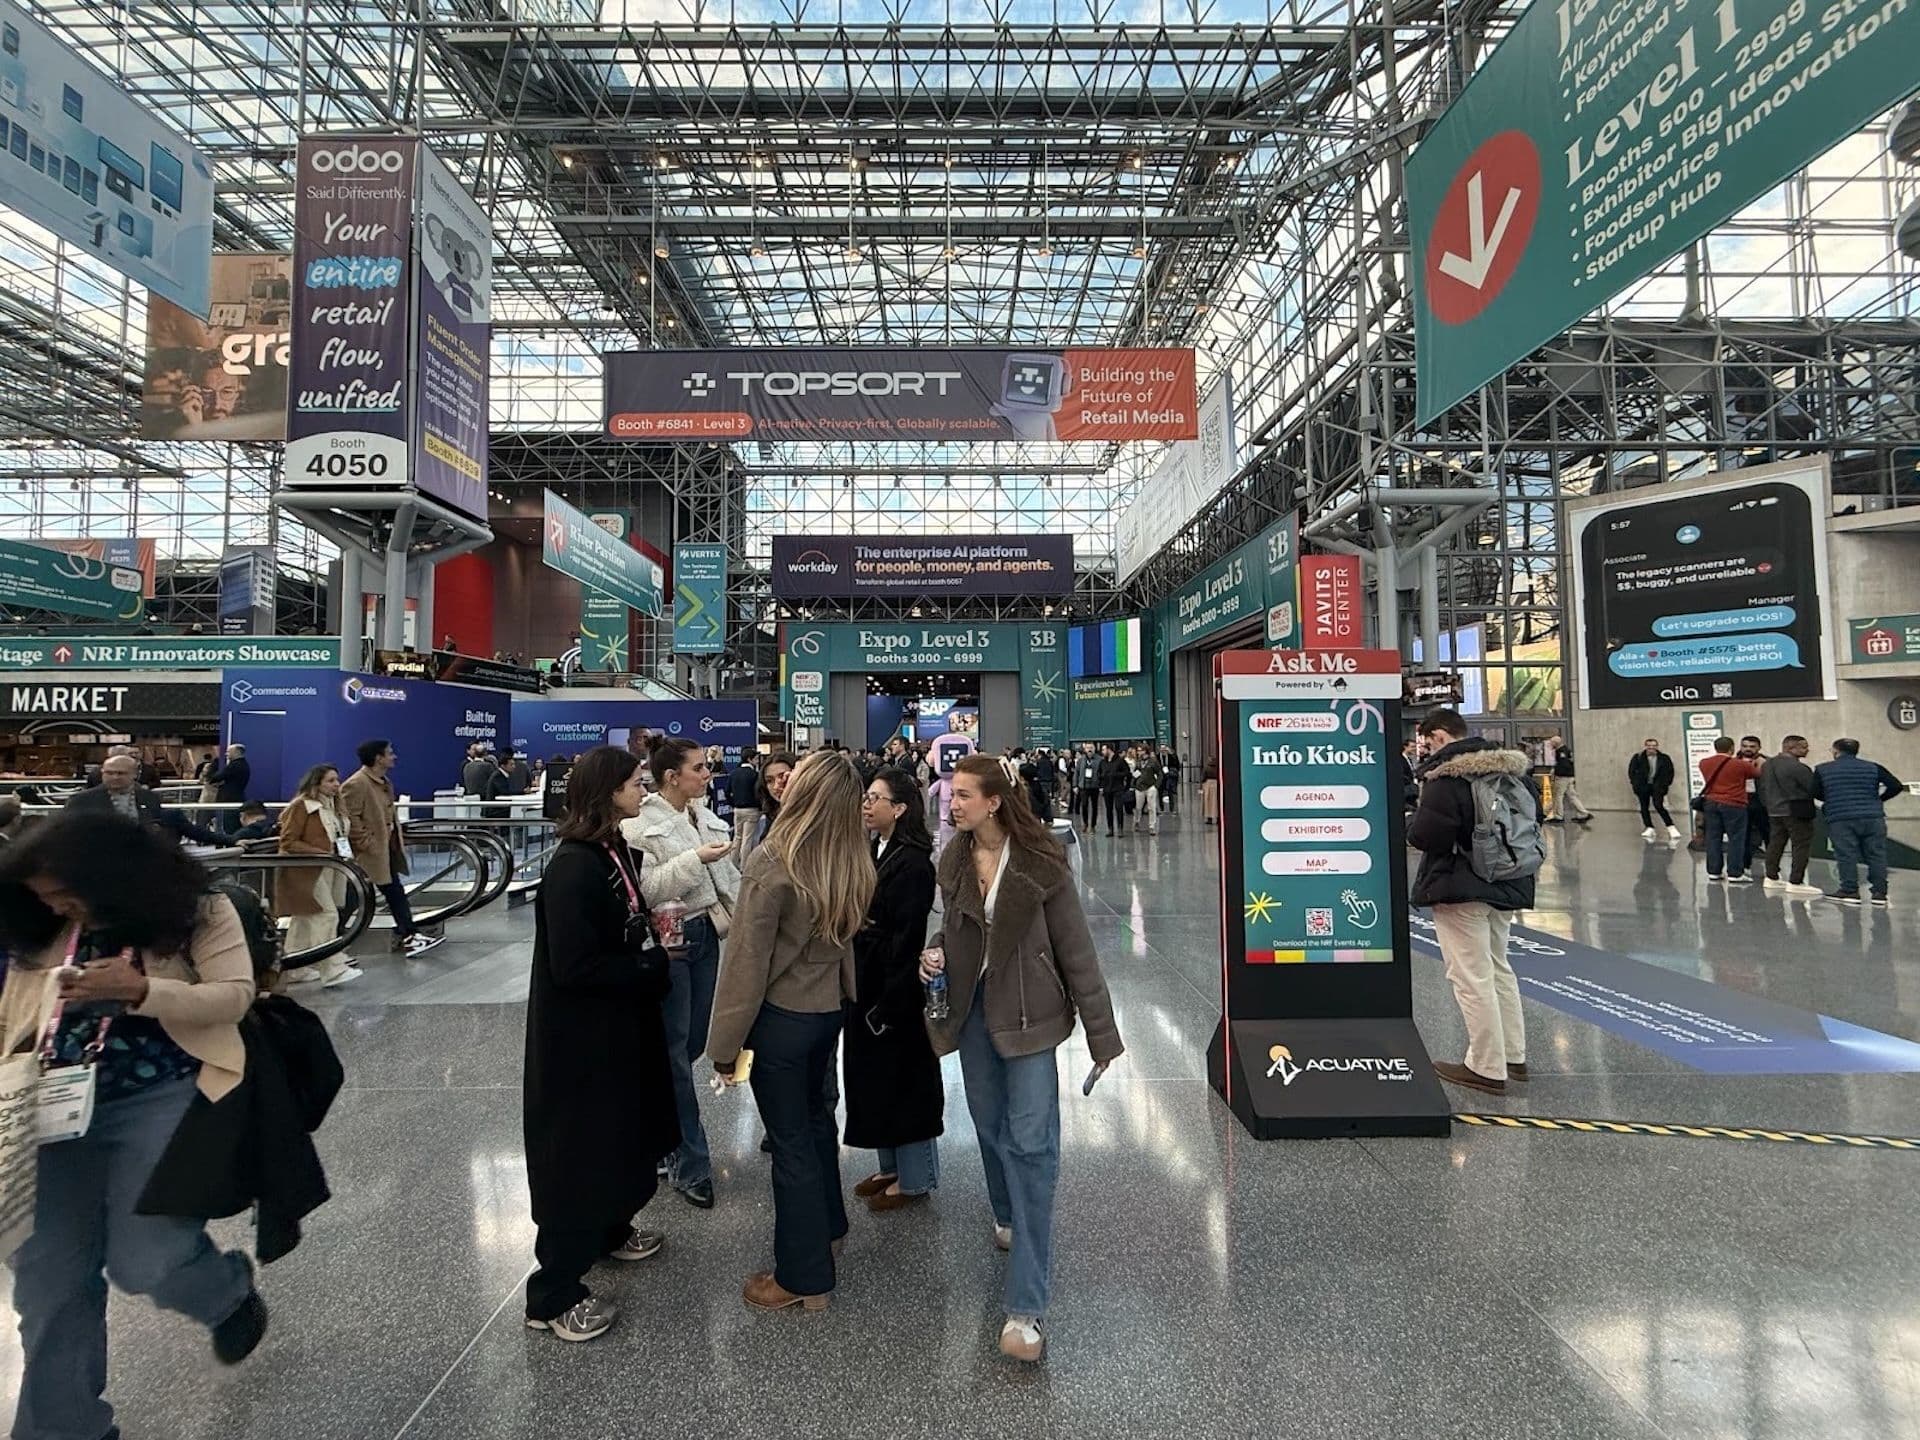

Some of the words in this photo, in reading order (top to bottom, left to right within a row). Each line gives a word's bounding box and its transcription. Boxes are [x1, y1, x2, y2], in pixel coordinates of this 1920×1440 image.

[1577, 5, 1670, 114] Featured
[1565, 25, 1700, 188] Level
[1713, 0, 1742, 53] 1
[1582, 136, 1653, 206] Booths
[1658, 87, 1704, 138] 500
[1735, 0, 1806, 74] 2999
[1584, 143, 1677, 231] Exhibitor
[1682, 105, 1723, 150] Big
[1729, 31, 1814, 111] Ideas
[1585, 141, 1720, 256] Foodservice
[1726, 0, 1907, 147] Innovation
[311, 144, 404, 173] odoo
[306, 186, 335, 200] Said
[338, 185, 407, 201] Differently.
[324, 211, 388, 245] Your
[1586, 213, 1665, 281] Startup
[1670, 170, 1722, 220] Hub
[310, 259, 396, 284] entire
[311, 297, 394, 325] retail
[427, 314, 458, 347] Fluent
[459, 338, 481, 366] Order
[319, 337, 384, 372] flow,
[427, 330, 484, 384] Management
[426, 351, 441, 370] The
[442, 365, 457, 383] only
[426, 366, 440, 382] you
[441, 376, 455, 391] can
[726, 371, 962, 397] TOPSORT
[1081, 367, 1145, 385] Building
[1149, 368, 1176, 382] the
[298, 378, 401, 413] unified.
[1081, 388, 1132, 403] Future
[1136, 388, 1154, 403] of
[459, 403, 471, 416] and
[1081, 410, 1128, 425] Retail
[1133, 410, 1185, 425] Media
[458, 412, 471, 428] with
[618, 419, 653, 430] Booth
[656, 419, 694, 430] #6841
[703, 418, 734, 430] Level
[737, 418, 746, 430] 3
[758, 418, 816, 429] AI-native.
[818, 418, 893, 431] Privacy-first.
[897, 418, 946, 431] Globally
[949, 418, 1001, 429] scalable.
[331, 438, 365, 449] Booth
[427, 438, 453, 463] Booth
[305, 454, 388, 477] 4050
[569, 524, 594, 550] River
[594, 539, 626, 571] Pavilion
[690, 550, 720, 558] VERTEX
[854, 546, 881, 558] The
[882, 546, 951, 560] enterprise
[952, 546, 968, 558] AI
[969, 545, 1029, 560] platform
[1267, 529, 1289, 564] 3B
[854, 560, 876, 572] for
[876, 560, 926, 575] people,
[927, 560, 975, 574] money,
[976, 560, 1000, 572] and
[1002, 559, 1054, 574] agents.
[1603, 553, 1647, 565] Associate
[788, 561, 839, 575] workday
[1615, 571, 1636, 581] The
[1636, 566, 1673, 580] legacy
[1674, 560, 1725, 574] scanners
[1726, 557, 1746, 567] are
[886, 578, 905, 587] global
[905, 578, 920, 586] retail
[928, 578, 946, 586] booth
[1636, 577, 1674, 590] buggy,
[1675, 574, 1698, 585] and
[1698, 566, 1756, 582] unreliable
[1179, 590, 1201, 618] Expo
[1205, 562, 1234, 602] Level
[1234, 558, 1243, 585] 3
[1316, 568, 1332, 637] JAVITS
[1337, 567, 1350, 637] CENTER
[1747, 594, 1795, 606] Manager
[1182, 617, 1201, 636] Booths
[1661, 620, 1689, 631] Let's
[1690, 617, 1740, 630] upgrade
[1741, 615, 1756, 624] to
[1756, 611, 1783, 623] iOS!
[859, 630, 911, 652] Expo
[921, 629, 976, 648] Level
[978, 629, 990, 648] 3
[1030, 630, 1056, 647] 3B
[0, 646, 43, 666] tage
[82, 646, 128, 662] NRF
[130, 646, 235, 662] Innovators
[238, 645, 331, 661] Showcase
[866, 652, 908, 664] Booths
[910, 653, 941, 664] 3000
[953, 653, 983, 664] 6999
[1617, 652, 1638, 661] Aila
[1660, 648, 1695, 658] Booth
[1697, 644, 1737, 655] #5575
[1738, 641, 1778, 652] better
[387, 662, 425, 673] gradial
[1266, 652, 1317, 673] Ask
[1320, 652, 1358, 673] Me
[1617, 661, 1650, 672] vision
[1649, 658, 1679, 669] tech,
[1680, 655, 1733, 667] reliability
[1734, 652, 1758, 663] and
[1759, 650, 1783, 661] ROI
[252, 686, 317, 696] commercetools
[1074, 680, 1116, 691] Experience
[1115, 678, 1129, 687] the
[1276, 681, 1312, 689] Powered
[1313, 681, 1325, 690] by
[1415, 684, 1452, 697] gradial
[11, 687, 129, 712] MARKET
[794, 692, 820, 705] The
[1074, 690, 1100, 700] Future
[1101, 689, 1109, 698] of
[1109, 687, 1133, 698] Retail
[1660, 685, 1700, 701] aila
[795, 704, 824, 716] Next
[919, 701, 949, 716] SAP
[465, 710, 485, 723] Built
[485, 711, 497, 724] for
[795, 714, 823, 726] Now
[1257, 718, 1283, 728] NRF
[454, 726, 497, 740] enterprise
[543, 722, 581, 732] Connect
[582, 723, 607, 733] every
[556, 733, 602, 741] customer.
[1252, 745, 1303, 766] Info
[1306, 745, 1377, 766] Kiosk
[1295, 793, 1336, 802] AGENDA
[1288, 826, 1344, 835] EXHIBITORS
[1306, 858, 1328, 867] MAP
[1272, 939, 1308, 948] Download
[1308, 939, 1320, 947] the
[1333, 939, 1356, 947] Events
[1356, 939, 1372, 949] App
[1305, 1058, 1410, 1072] ACUATIVE
[1377, 1073, 1387, 1081] Be
[1388, 1073, 1412, 1082] Ready!
